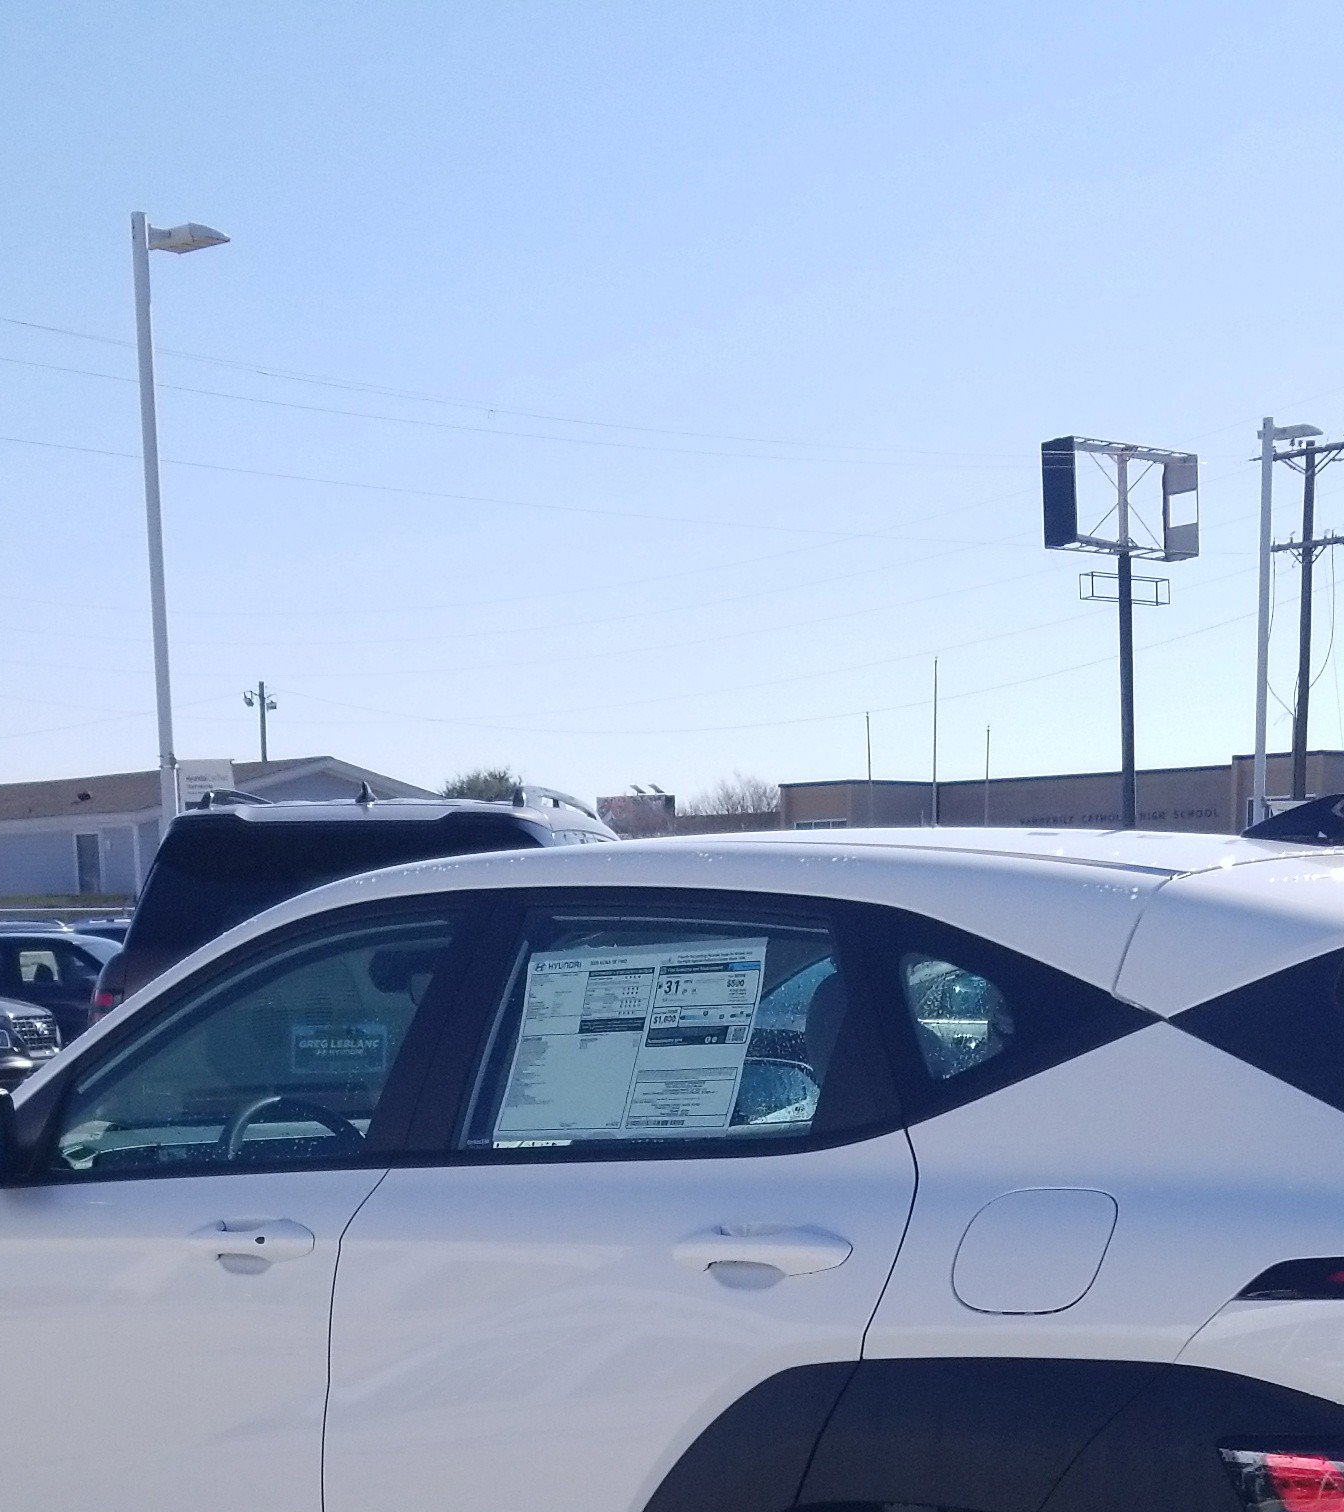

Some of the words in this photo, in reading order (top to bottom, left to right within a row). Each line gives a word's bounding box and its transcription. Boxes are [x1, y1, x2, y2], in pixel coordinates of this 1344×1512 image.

[1173, 808, 1220, 820] SCHOOL
[548, 961, 582, 970] HYUNDAI
[664, 980, 680, 994] 31
